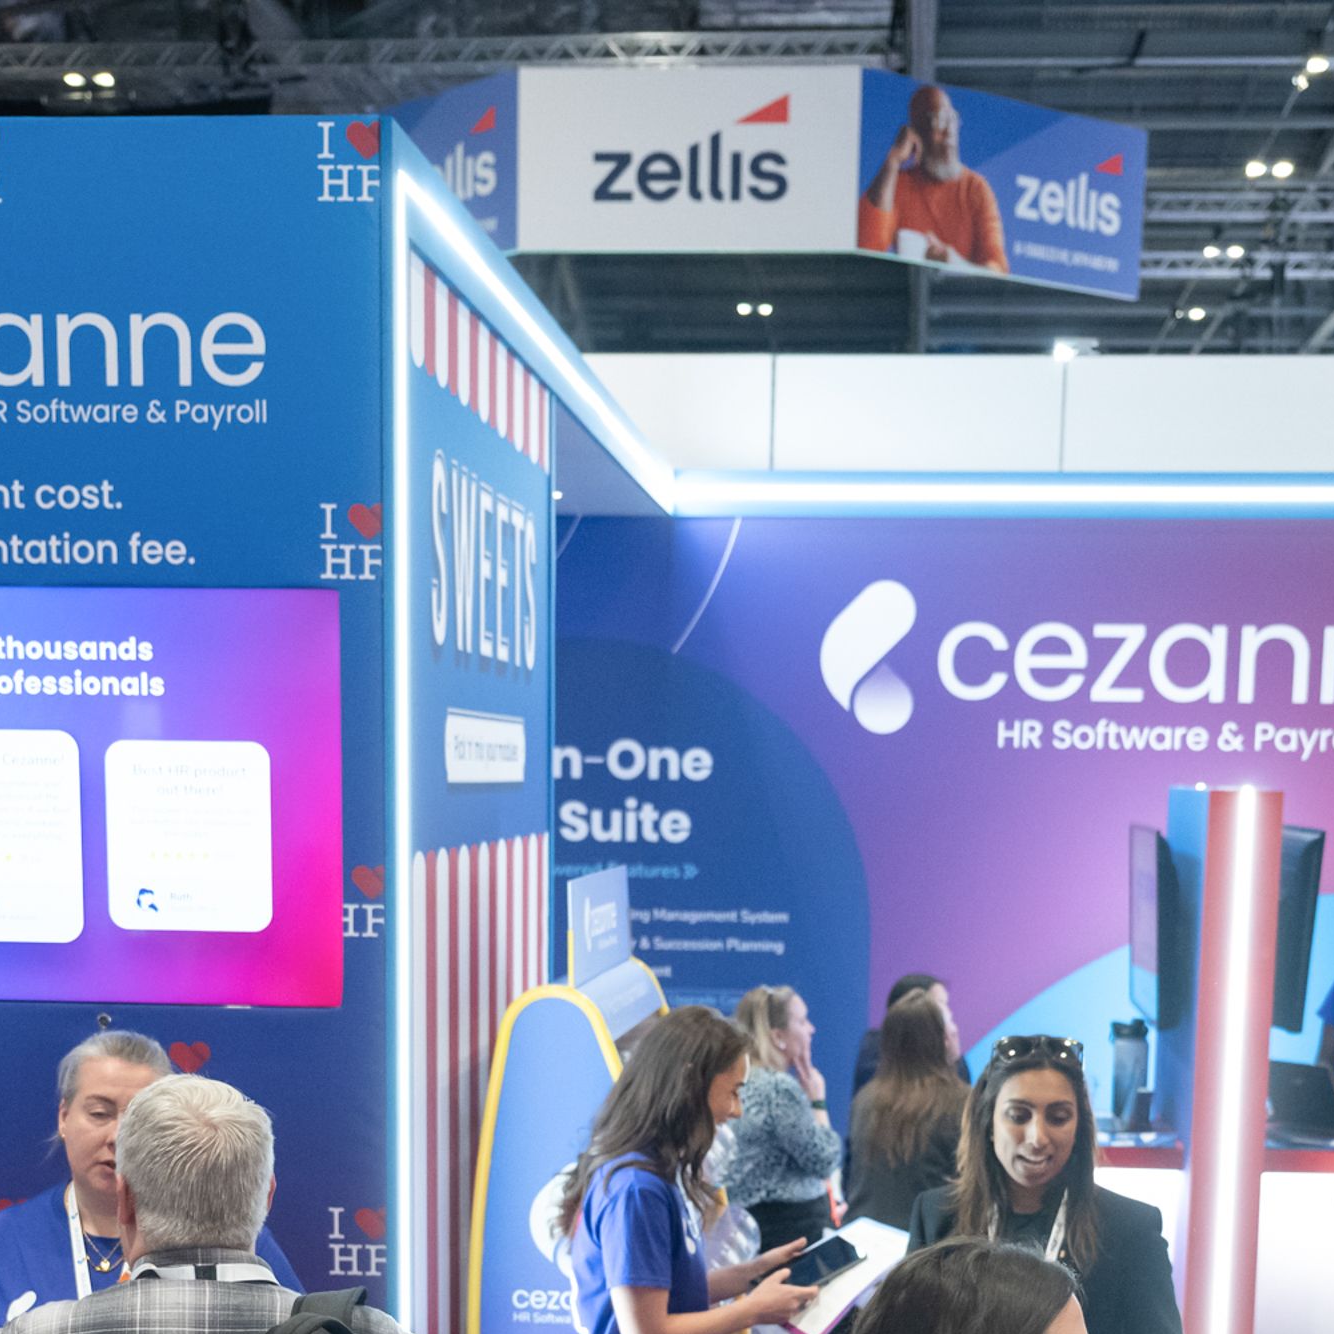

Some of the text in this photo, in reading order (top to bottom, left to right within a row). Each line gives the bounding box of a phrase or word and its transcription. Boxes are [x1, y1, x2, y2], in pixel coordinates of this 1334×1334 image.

[317, 121, 335, 160] I
[433, 141, 497, 201] llis
[593, 129, 789, 202] zellis
[1014, 172, 1122, 237] zellis
[16, 398, 139, 426] Software
[145, 400, 168, 425] &
[175, 399, 268, 431] Payroll
[35, 482, 123, 510] cost.
[319, 502, 338, 540] I
[128, 533, 196, 566] fee.
[431, 448, 537, 672] SWEETS
[996, 720, 1042, 751] HR
[1052, 720, 1209, 752] Software
[1218, 724, 1244, 752] &
[194, 764, 246, 780] product
[559, 796, 693, 844] Suite
[653, 907, 738, 927] Management
[740, 909, 790, 927] System
[653, 936, 724, 952] Succession
[725, 938, 786, 956] Planning
[328, 1207, 345, 1239] I
